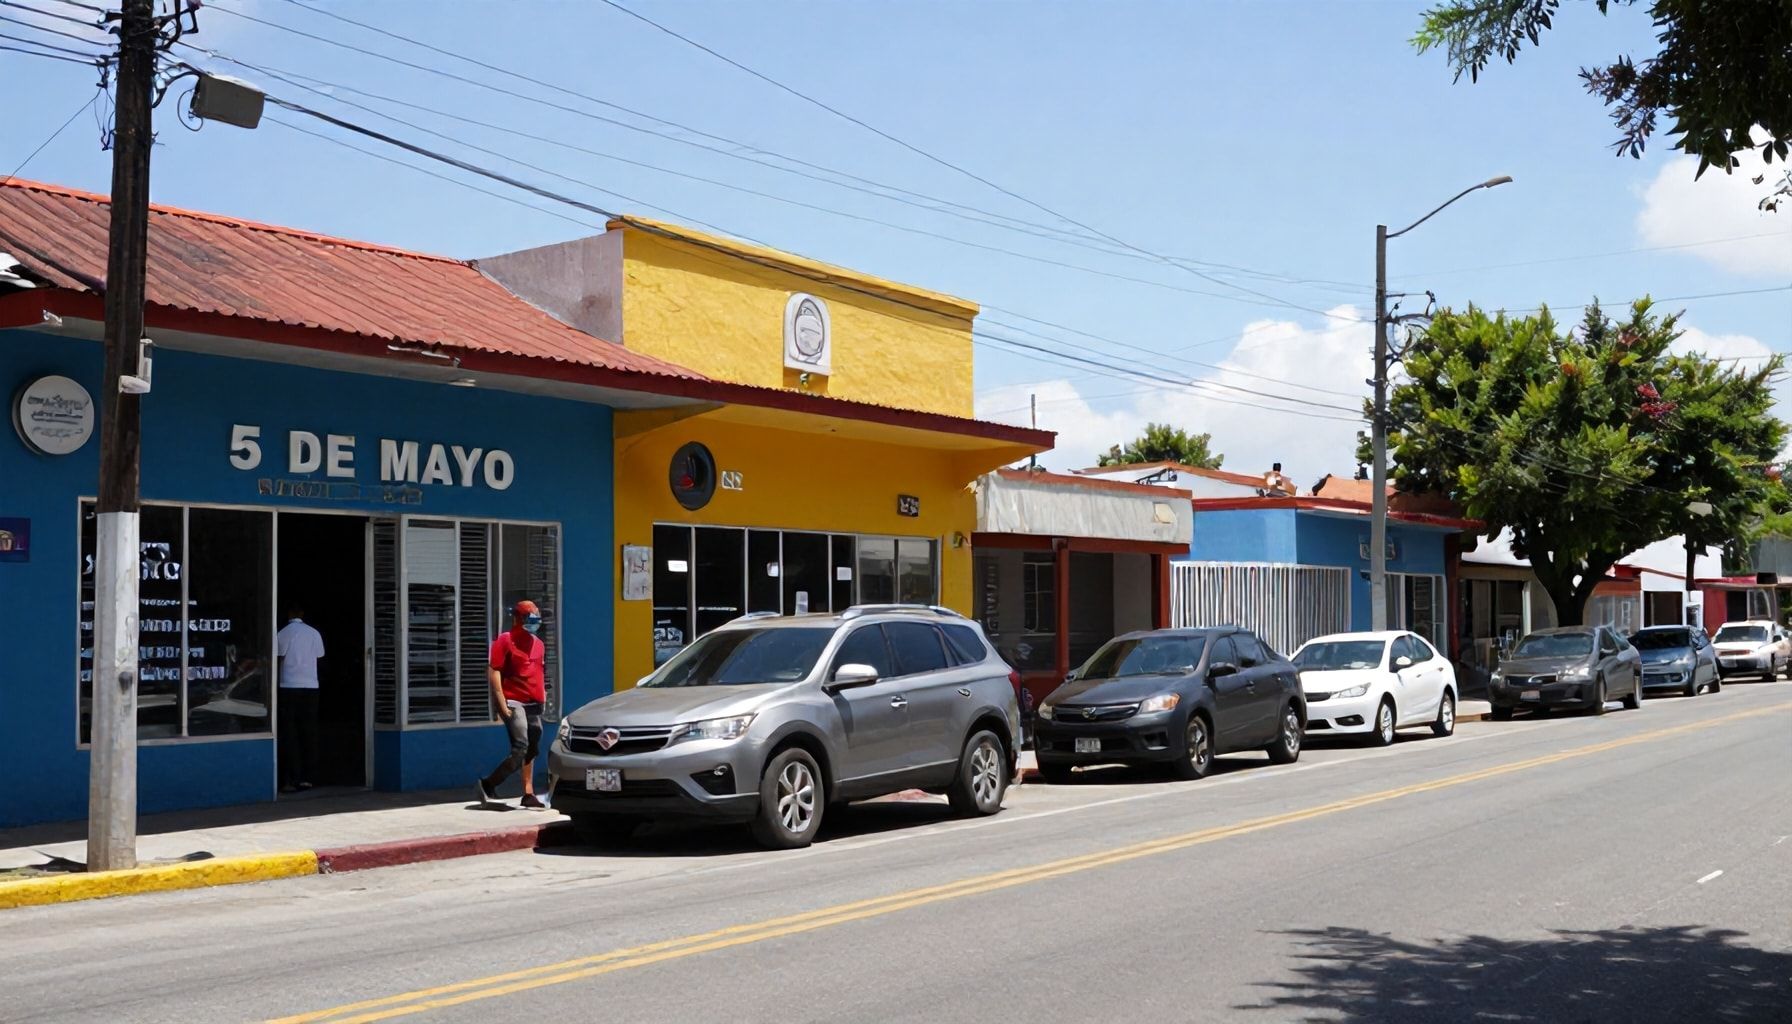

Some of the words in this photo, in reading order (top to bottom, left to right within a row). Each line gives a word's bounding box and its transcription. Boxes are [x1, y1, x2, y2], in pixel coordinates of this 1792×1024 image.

[229, 424, 262, 470] 5
[289, 430, 355, 478] DE
[381, 438, 515, 490] MAYO
